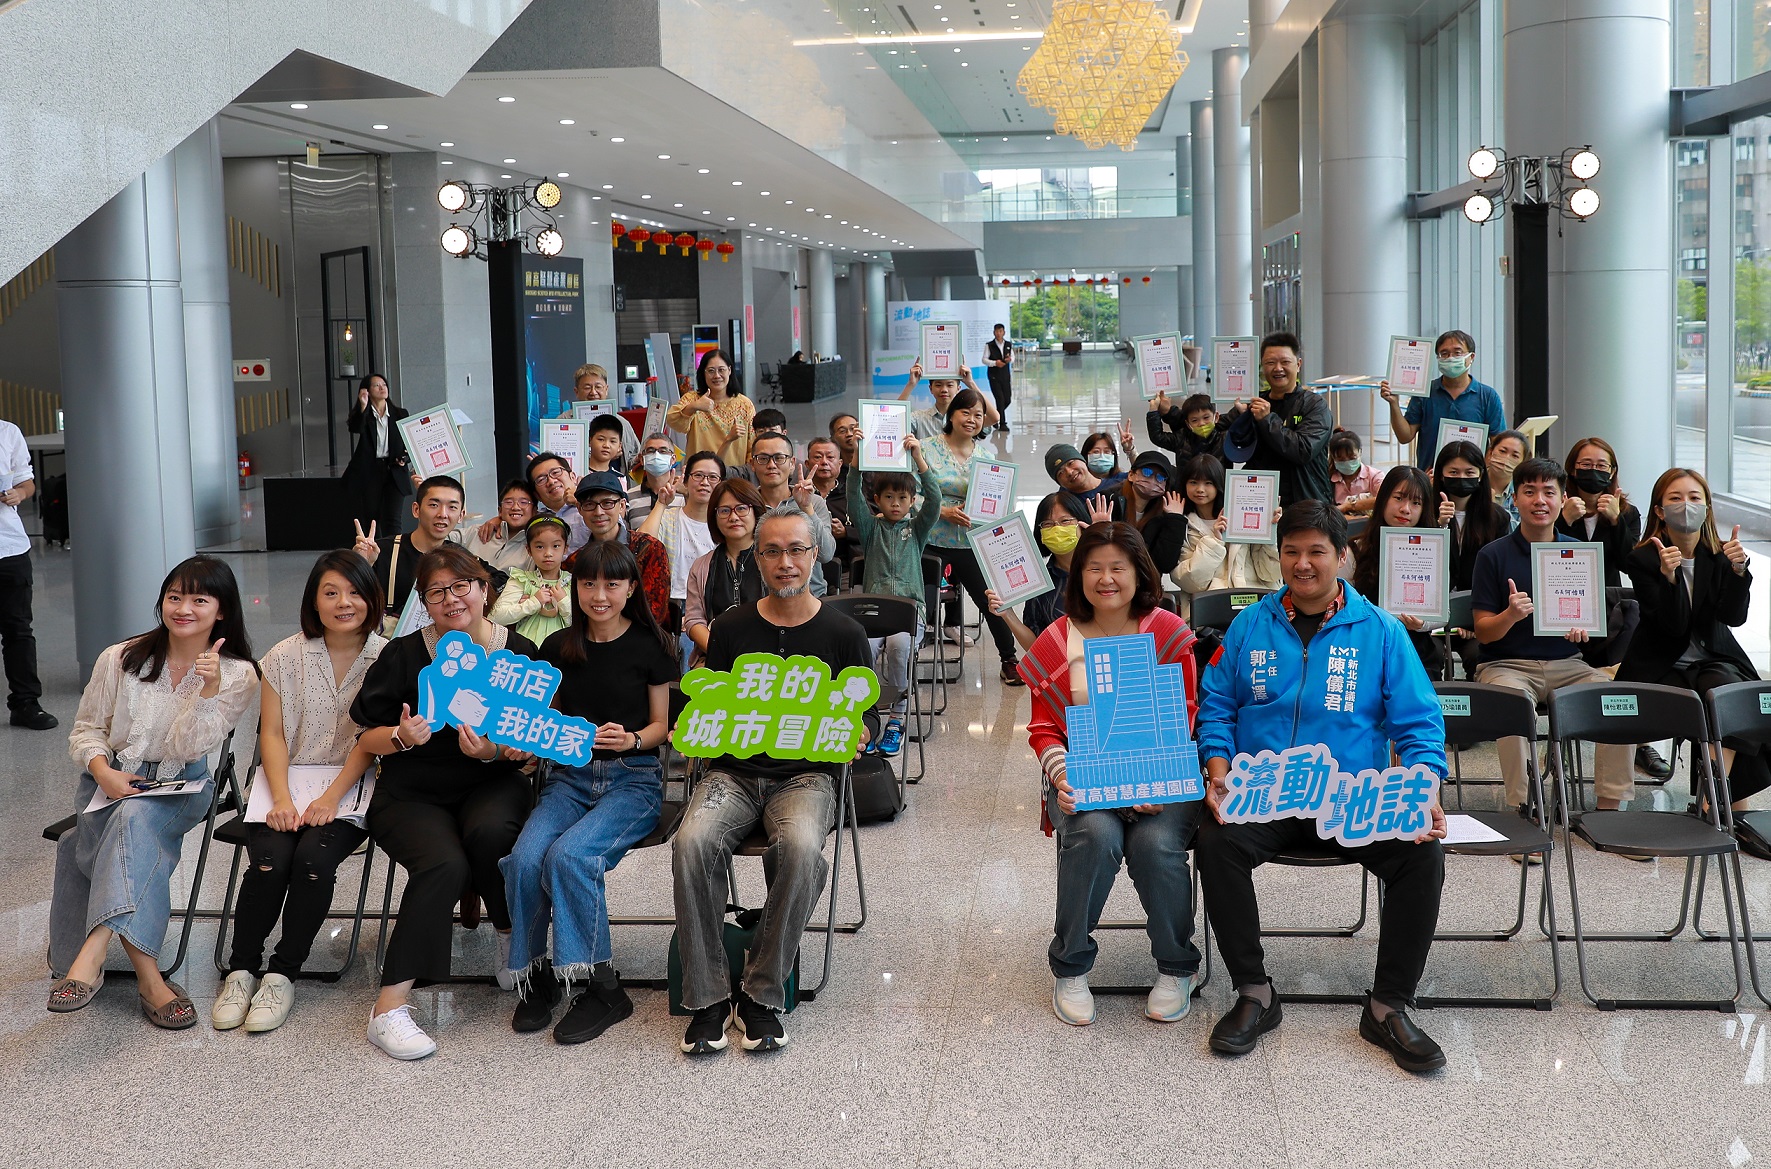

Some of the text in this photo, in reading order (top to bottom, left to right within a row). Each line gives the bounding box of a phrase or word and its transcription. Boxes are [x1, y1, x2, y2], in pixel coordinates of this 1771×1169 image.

[894, 306, 931, 321] 流動地誌
[1267, 649, 1278, 677] 主任
[1329, 645, 1359, 658] KMT
[488, 657, 553, 702] 新店
[736, 662, 821, 703] 我的
[1250, 649, 1268, 701] 郭仁澤
[1324, 656, 1346, 712] 陳儀君
[1343, 659, 1359, 713] 新北市議員
[1440, 703, 1468, 711] 乃瑜議員
[496, 706, 590, 758] 我的家
[682, 709, 854, 752] 城市冒險
[1073, 778, 1199, 804] 寶高智慧產業園區
[1226, 751, 1434, 840] 流動地誌
